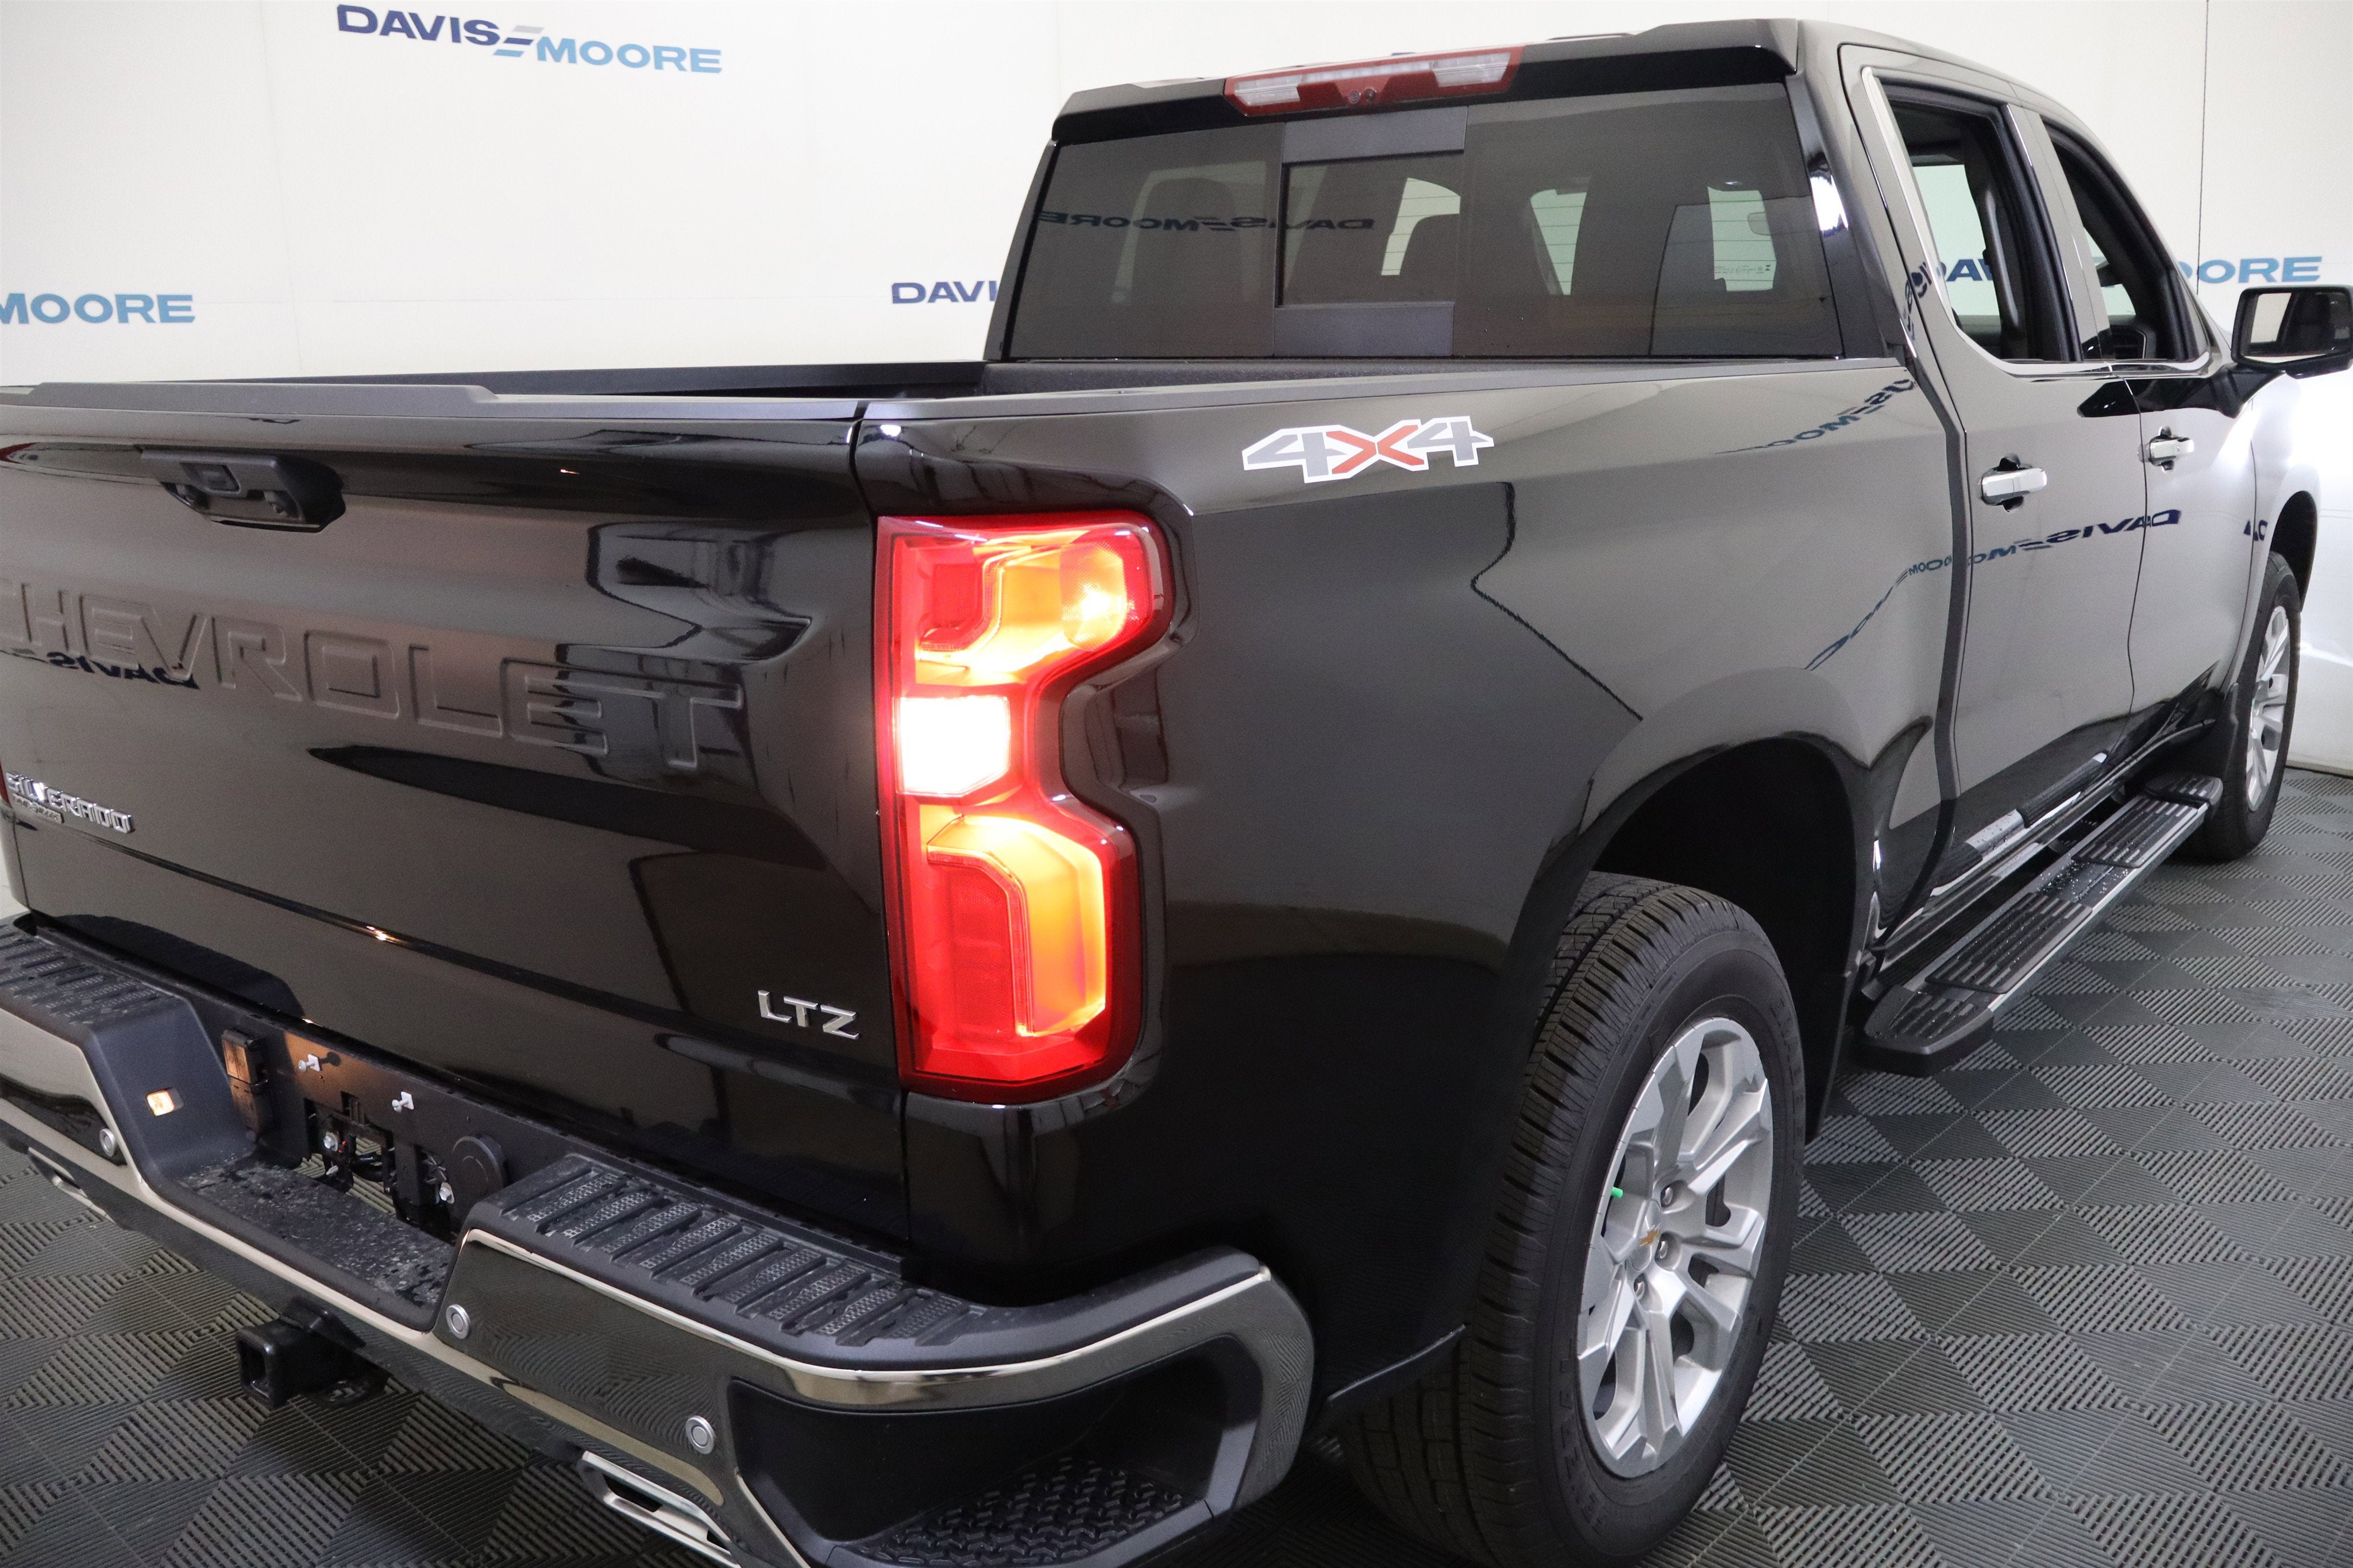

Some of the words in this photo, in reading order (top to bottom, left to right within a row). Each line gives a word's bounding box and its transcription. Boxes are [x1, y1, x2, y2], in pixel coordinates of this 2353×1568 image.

[337, 4, 501, 46] DAVIS
[536, 36, 723, 74] MOORE
[0, 293, 195, 324] MOORE
[1241, 416, 1495, 484] 4X4
[6, 772, 134, 833] SILVERADO
[758, 990, 859, 1040] LTZ
